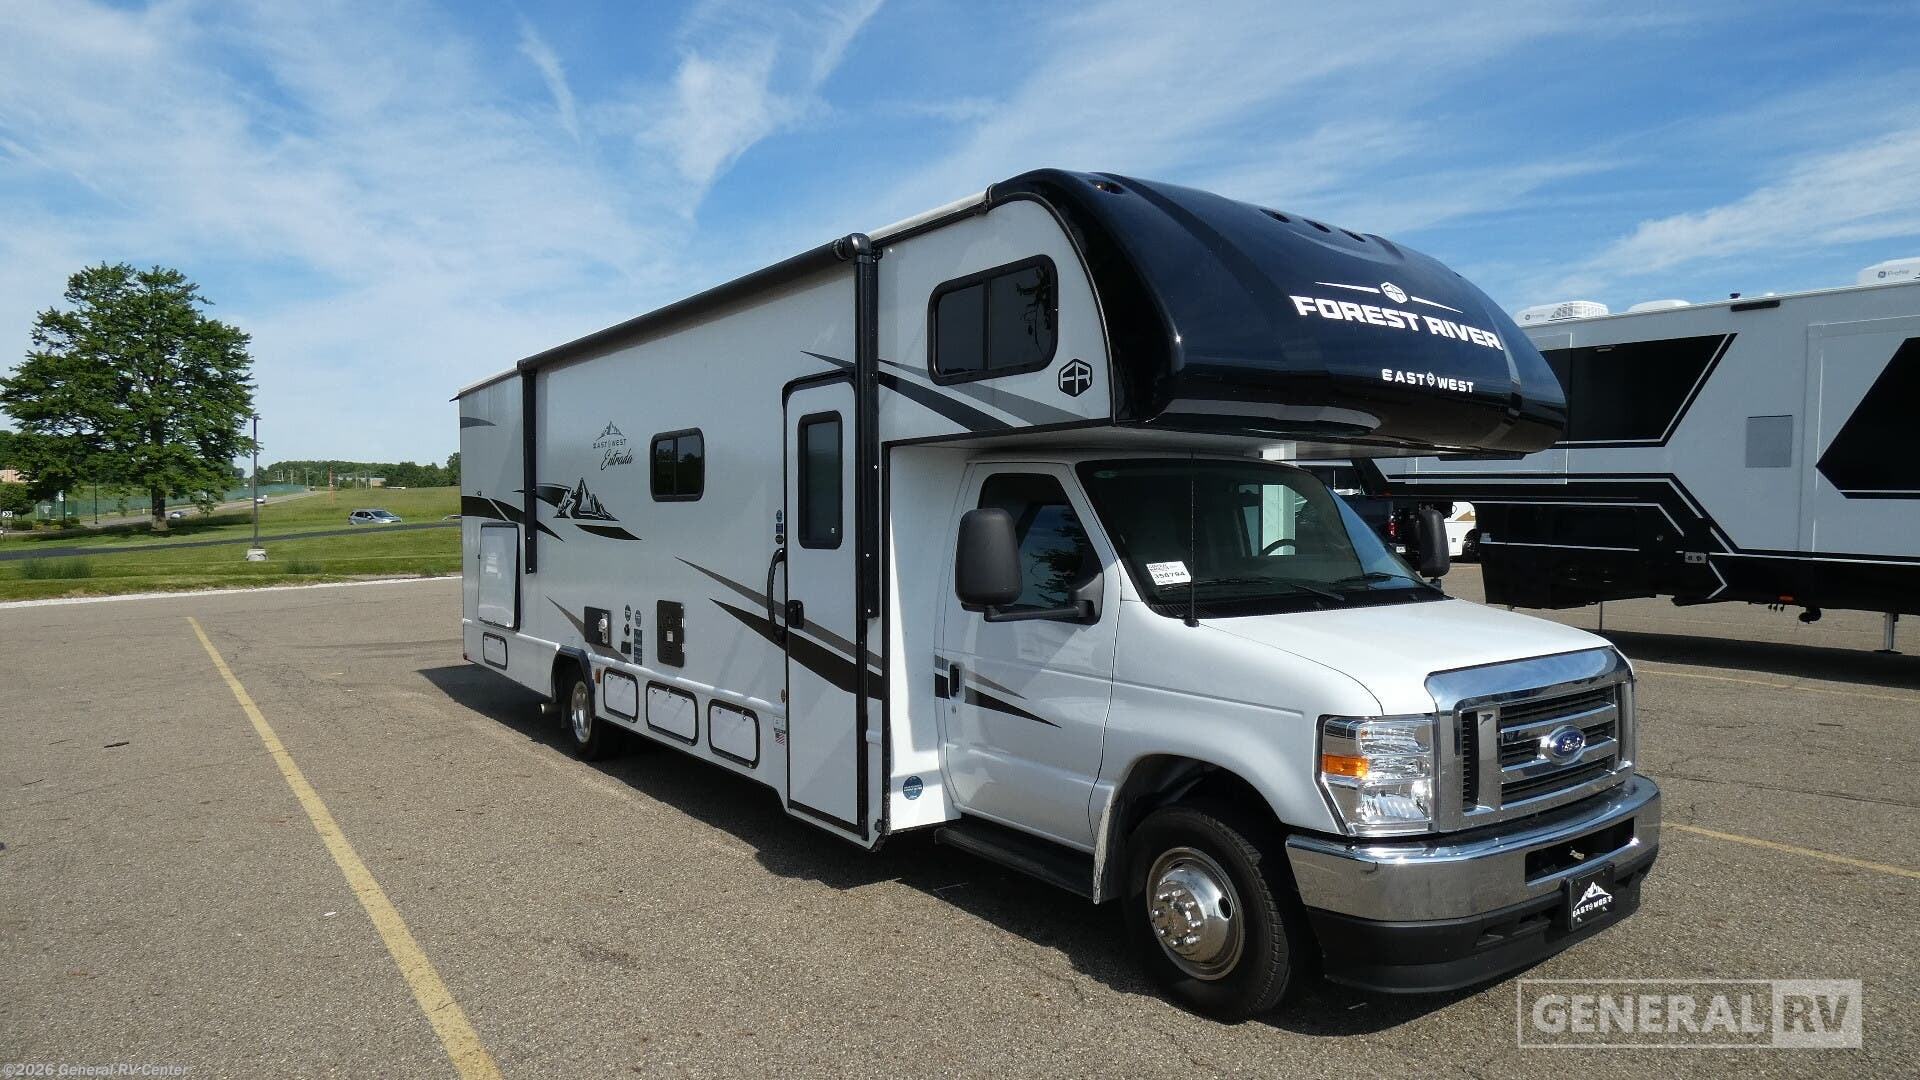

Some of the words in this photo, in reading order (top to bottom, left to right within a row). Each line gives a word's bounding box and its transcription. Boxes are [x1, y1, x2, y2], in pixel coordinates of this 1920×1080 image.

[1289, 295, 1420, 331] FOREST
[1422, 315, 1503, 350] RIVER
[1381, 368, 1425, 386] EAST
[1436, 376, 1474, 393] WEST
[600, 447, 633, 471] Entrada
[1572, 905, 1589, 917] EAST
[1593, 895, 1613, 908] WEST
